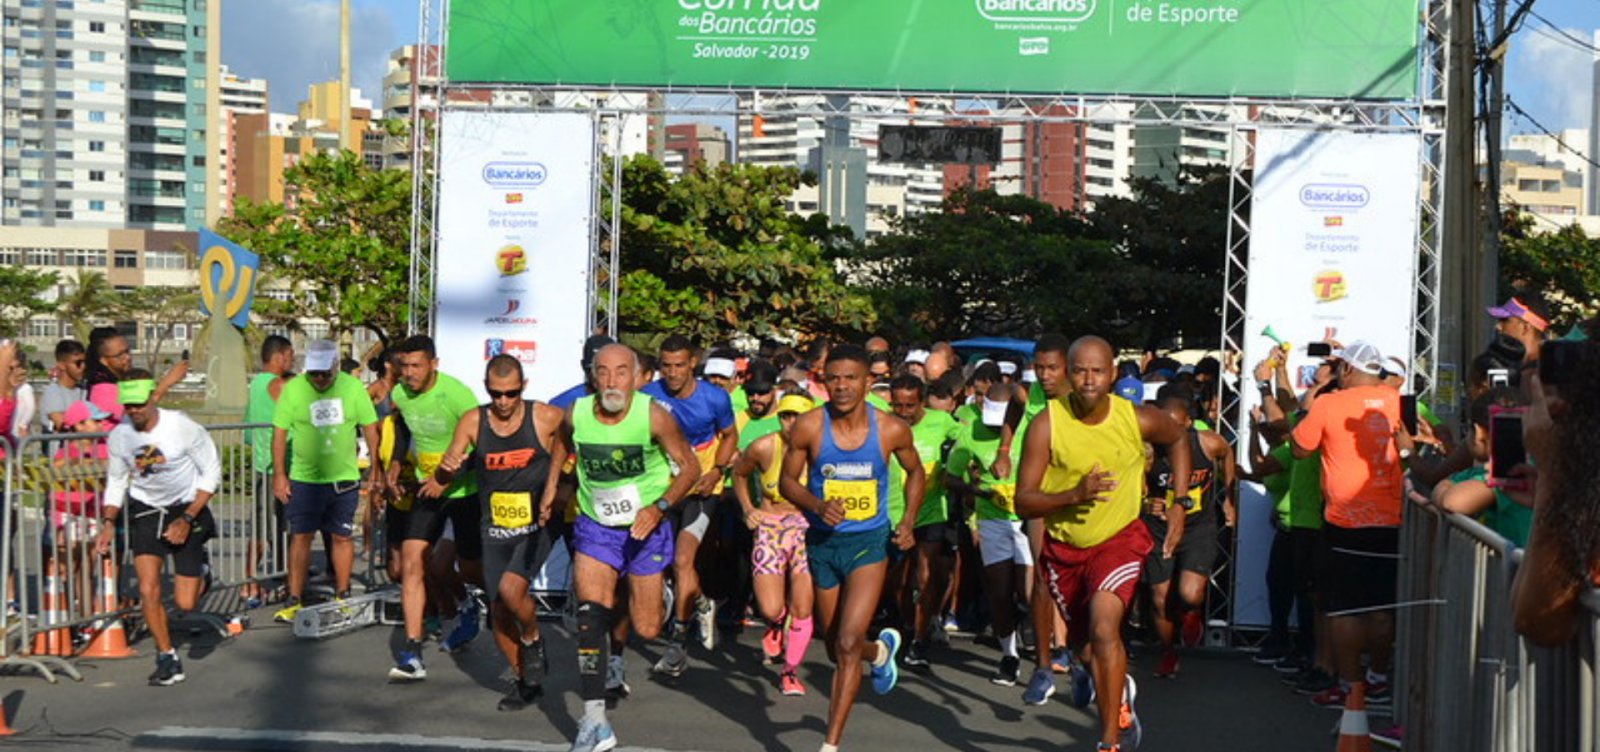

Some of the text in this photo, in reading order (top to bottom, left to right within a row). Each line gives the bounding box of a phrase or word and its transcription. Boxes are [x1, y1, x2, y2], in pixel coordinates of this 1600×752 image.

[1126, 3, 1239, 26] de Esporte
[679, 11, 817, 36] dos Bancários
[692, 42, 759, 58] Salvador
[486, 167, 542, 180] Bancários
[1304, 188, 1365, 202] Bancários
[601, 499, 633, 517] 318
[829, 495, 871, 511] 96
[493, 505, 529, 519] 1096
